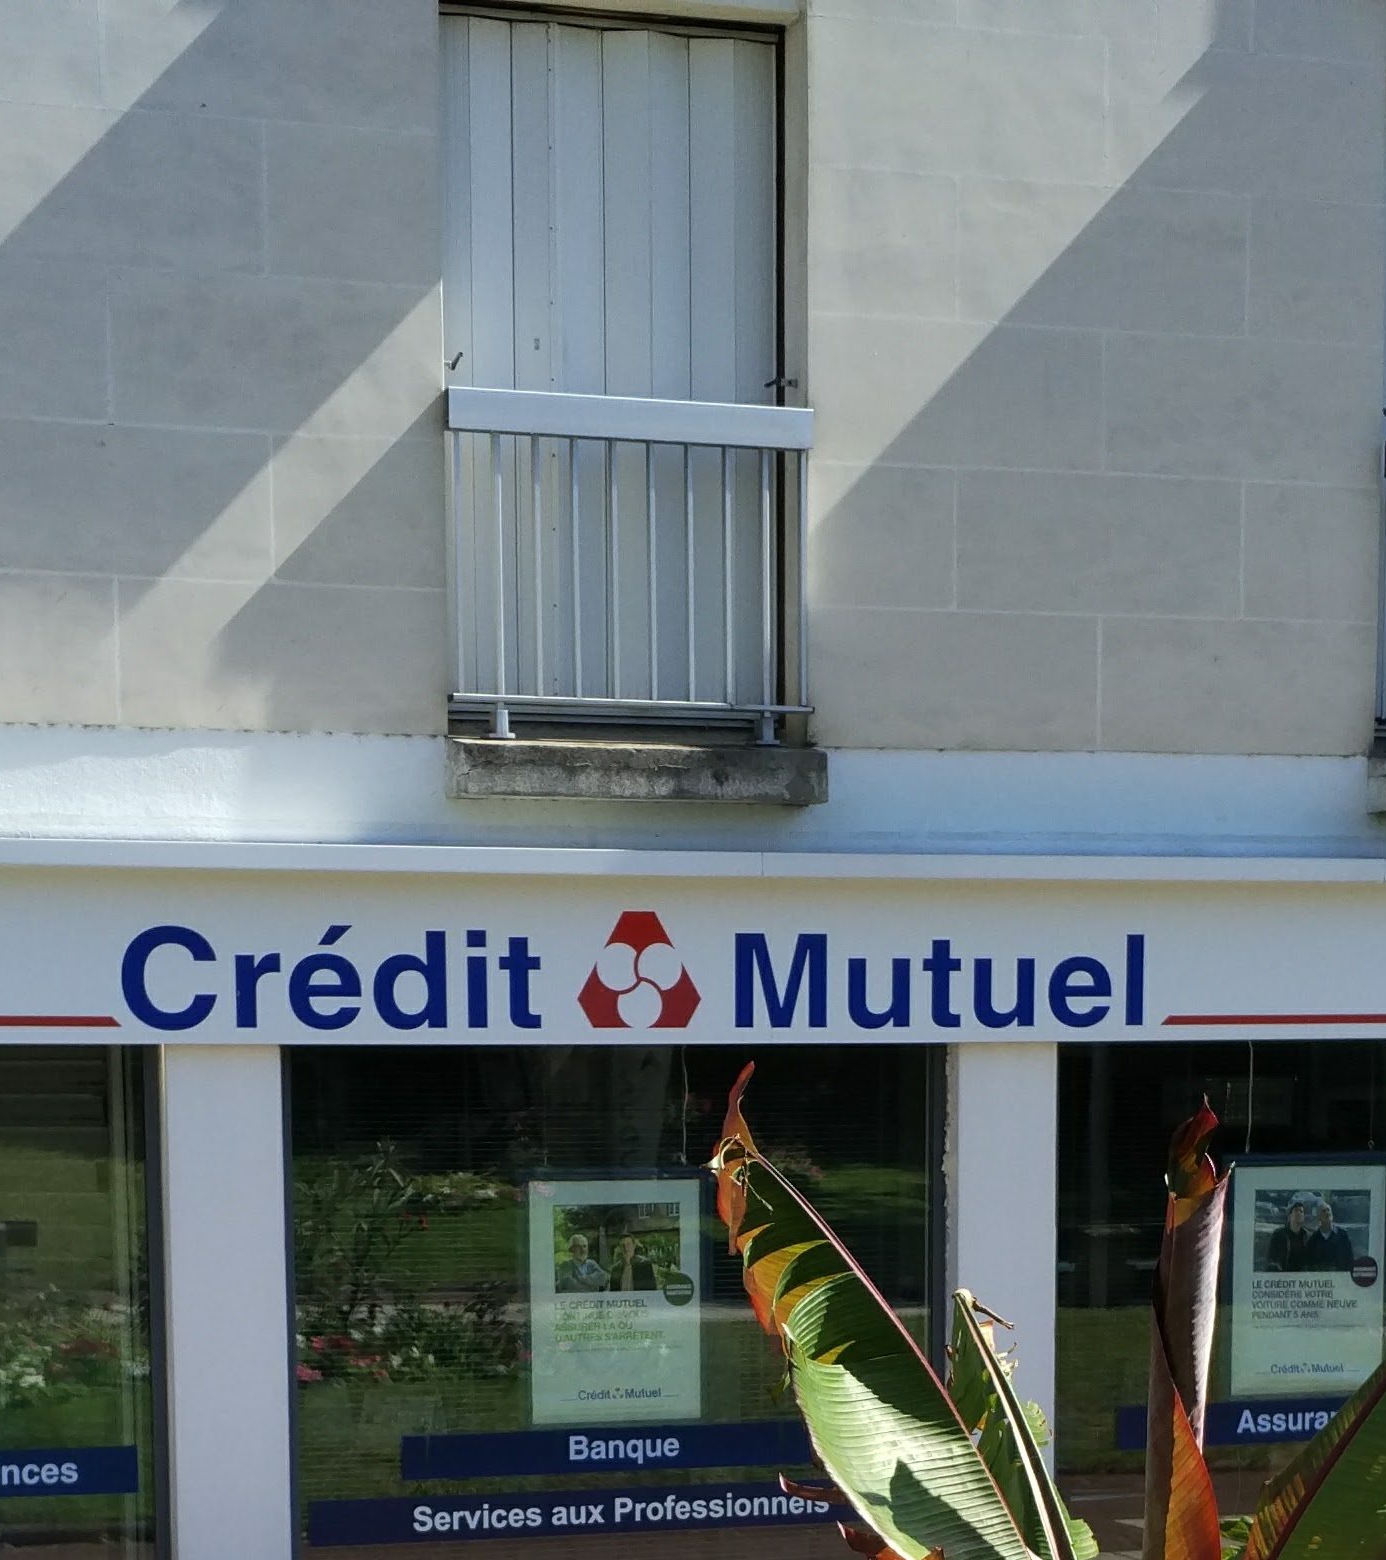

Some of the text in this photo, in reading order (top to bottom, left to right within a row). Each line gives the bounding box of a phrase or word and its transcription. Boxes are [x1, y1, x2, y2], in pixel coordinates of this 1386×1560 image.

[120, 925, 1145, 1031] Crédit Mutuel
[1252, 1278, 1335, 1289] LE CRÉDIT MUTUEL
[1304, 1289, 1333, 1299] VOTRE
[554, 1301, 566, 1311] LE
[606, 1298, 648, 1309] MUTUEL
[1252, 1299, 1358, 1310] VOITURE COMME NEUVE
[1251, 1310, 1292, 1320] PENDANT
[1270, 1362, 1345, 1374] Crédit Mutuel
[578, 1387, 662, 1400] Crédit Mutuel
[569, 1434, 680, 1464] Banque
[412, 1492, 830, 1532] Services aux Professionnels
